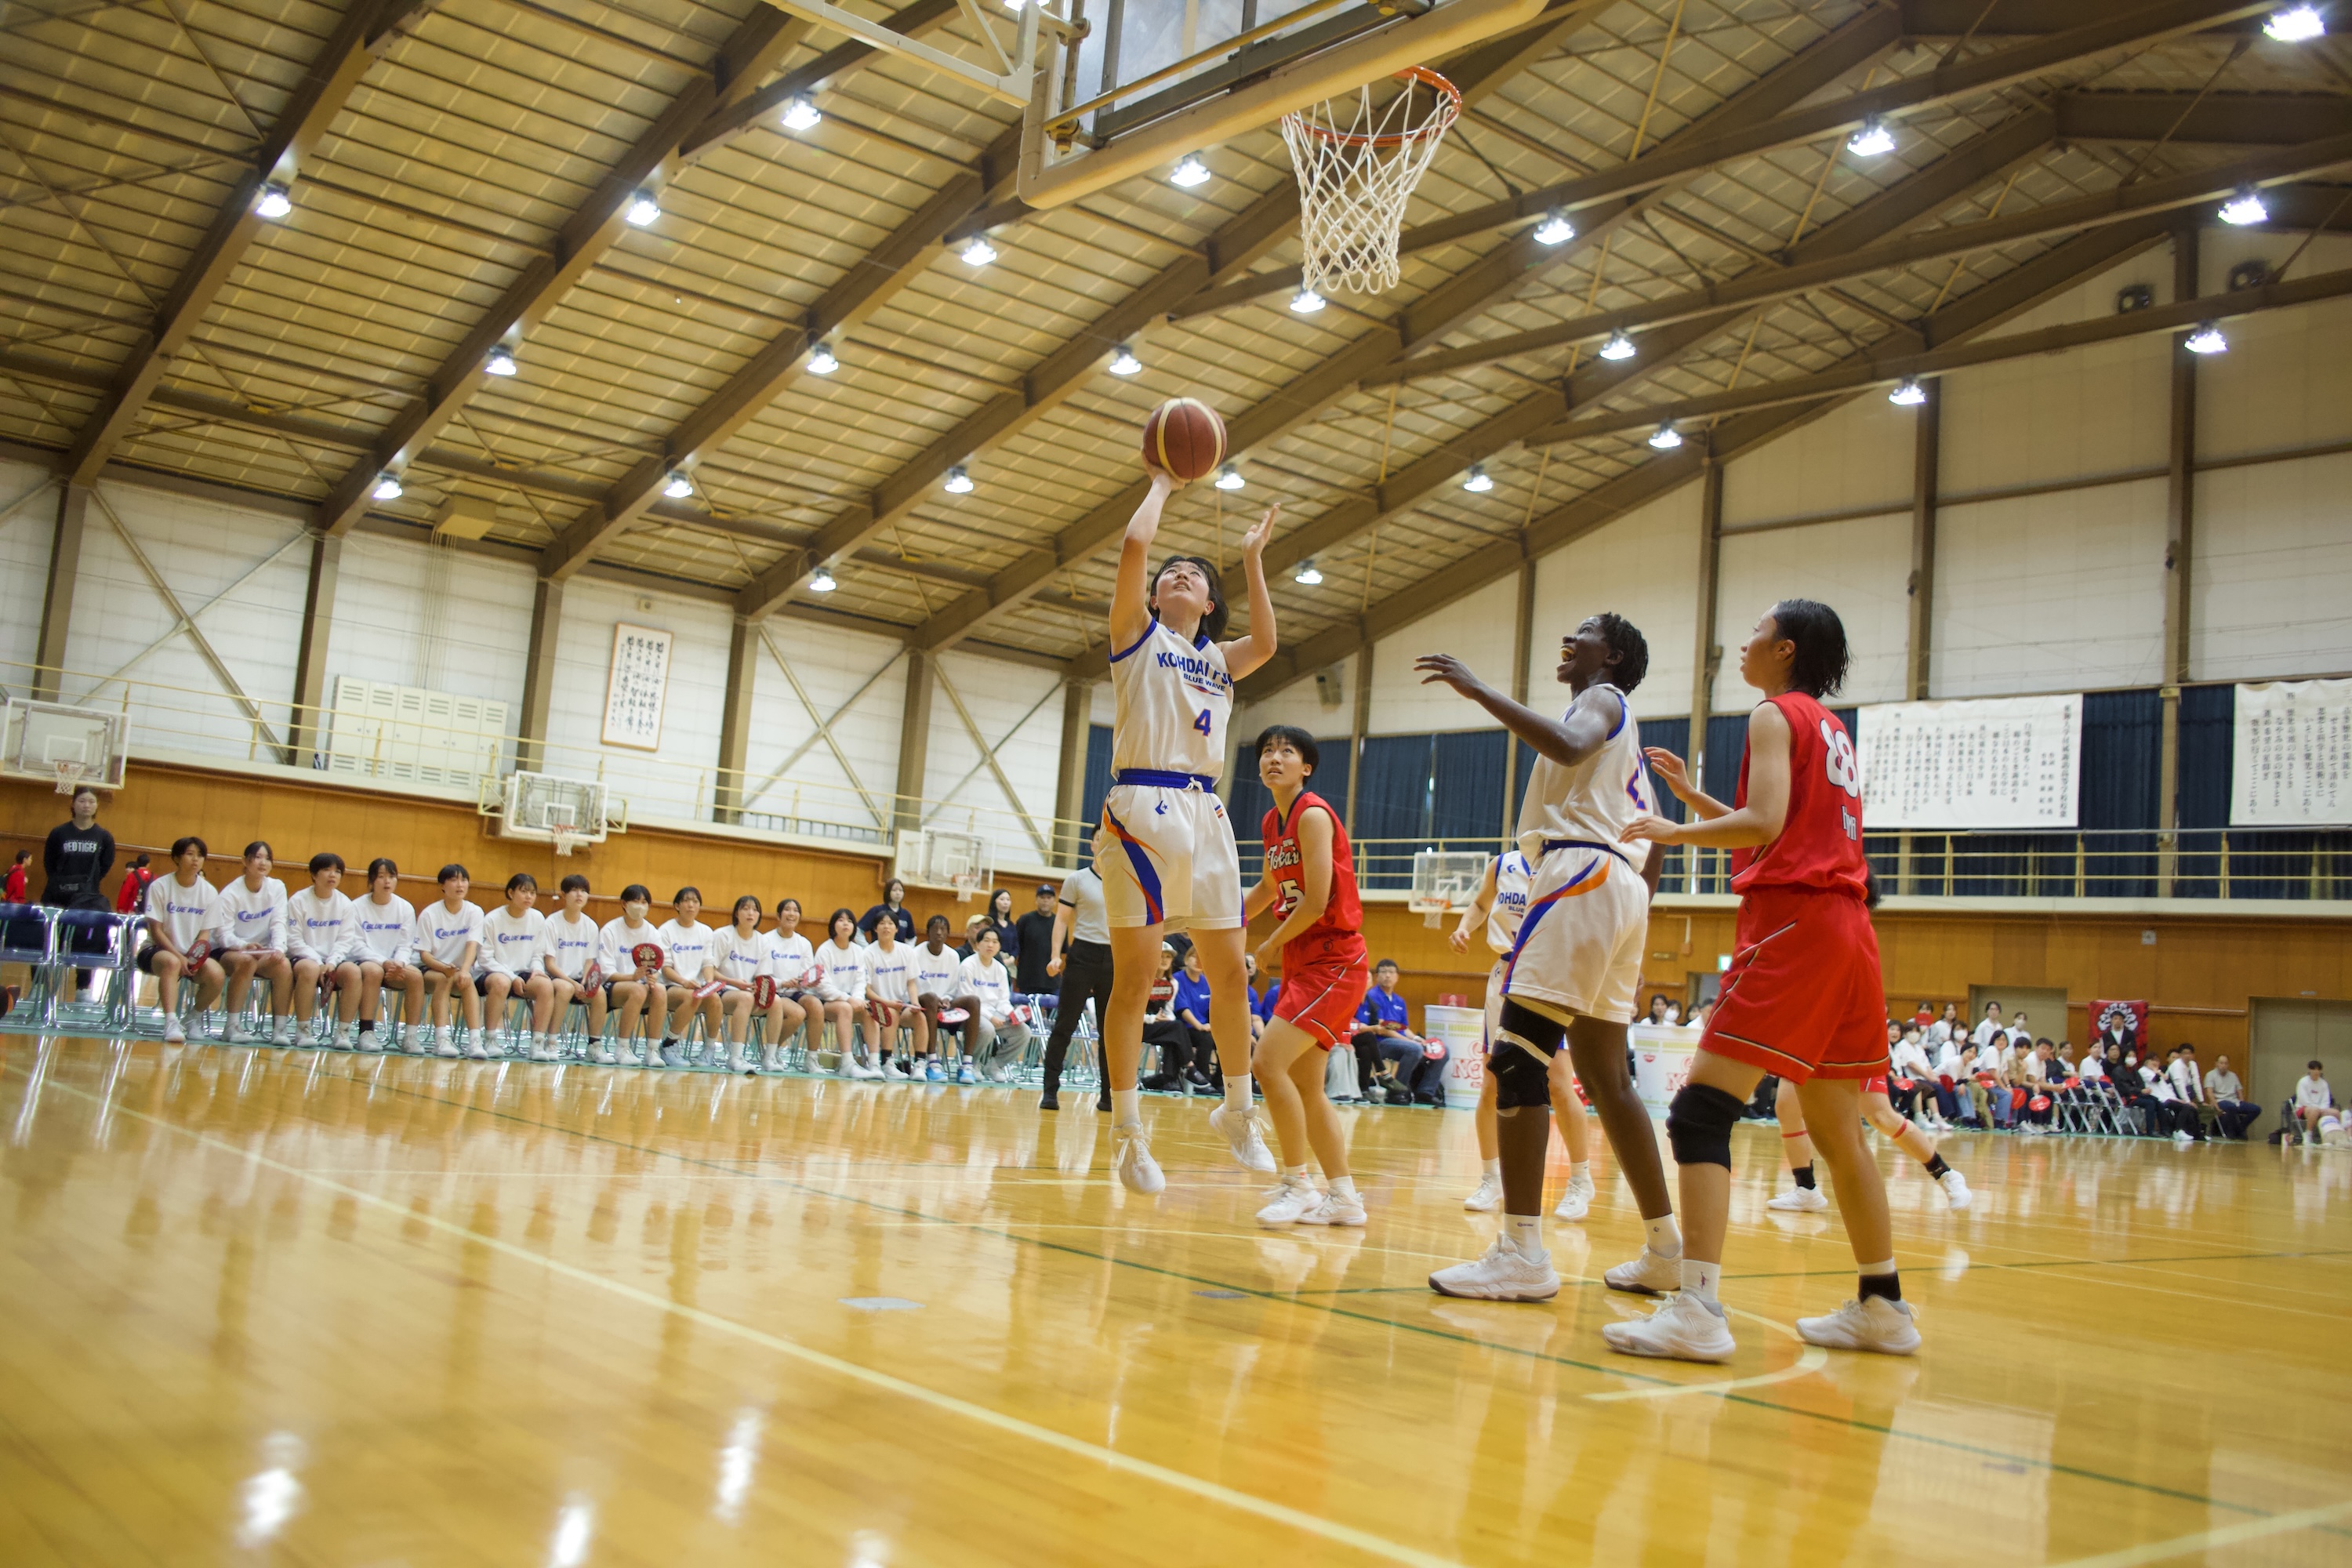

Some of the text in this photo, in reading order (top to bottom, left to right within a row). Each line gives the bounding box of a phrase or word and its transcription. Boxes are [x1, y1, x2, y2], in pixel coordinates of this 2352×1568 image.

[1156, 652, 1210, 677] KOHDAI
[1183, 673, 1225, 691] BLUE WAVE
[1193, 709, 1211, 737] 4
[1267, 845, 1299, 872] Tokai
